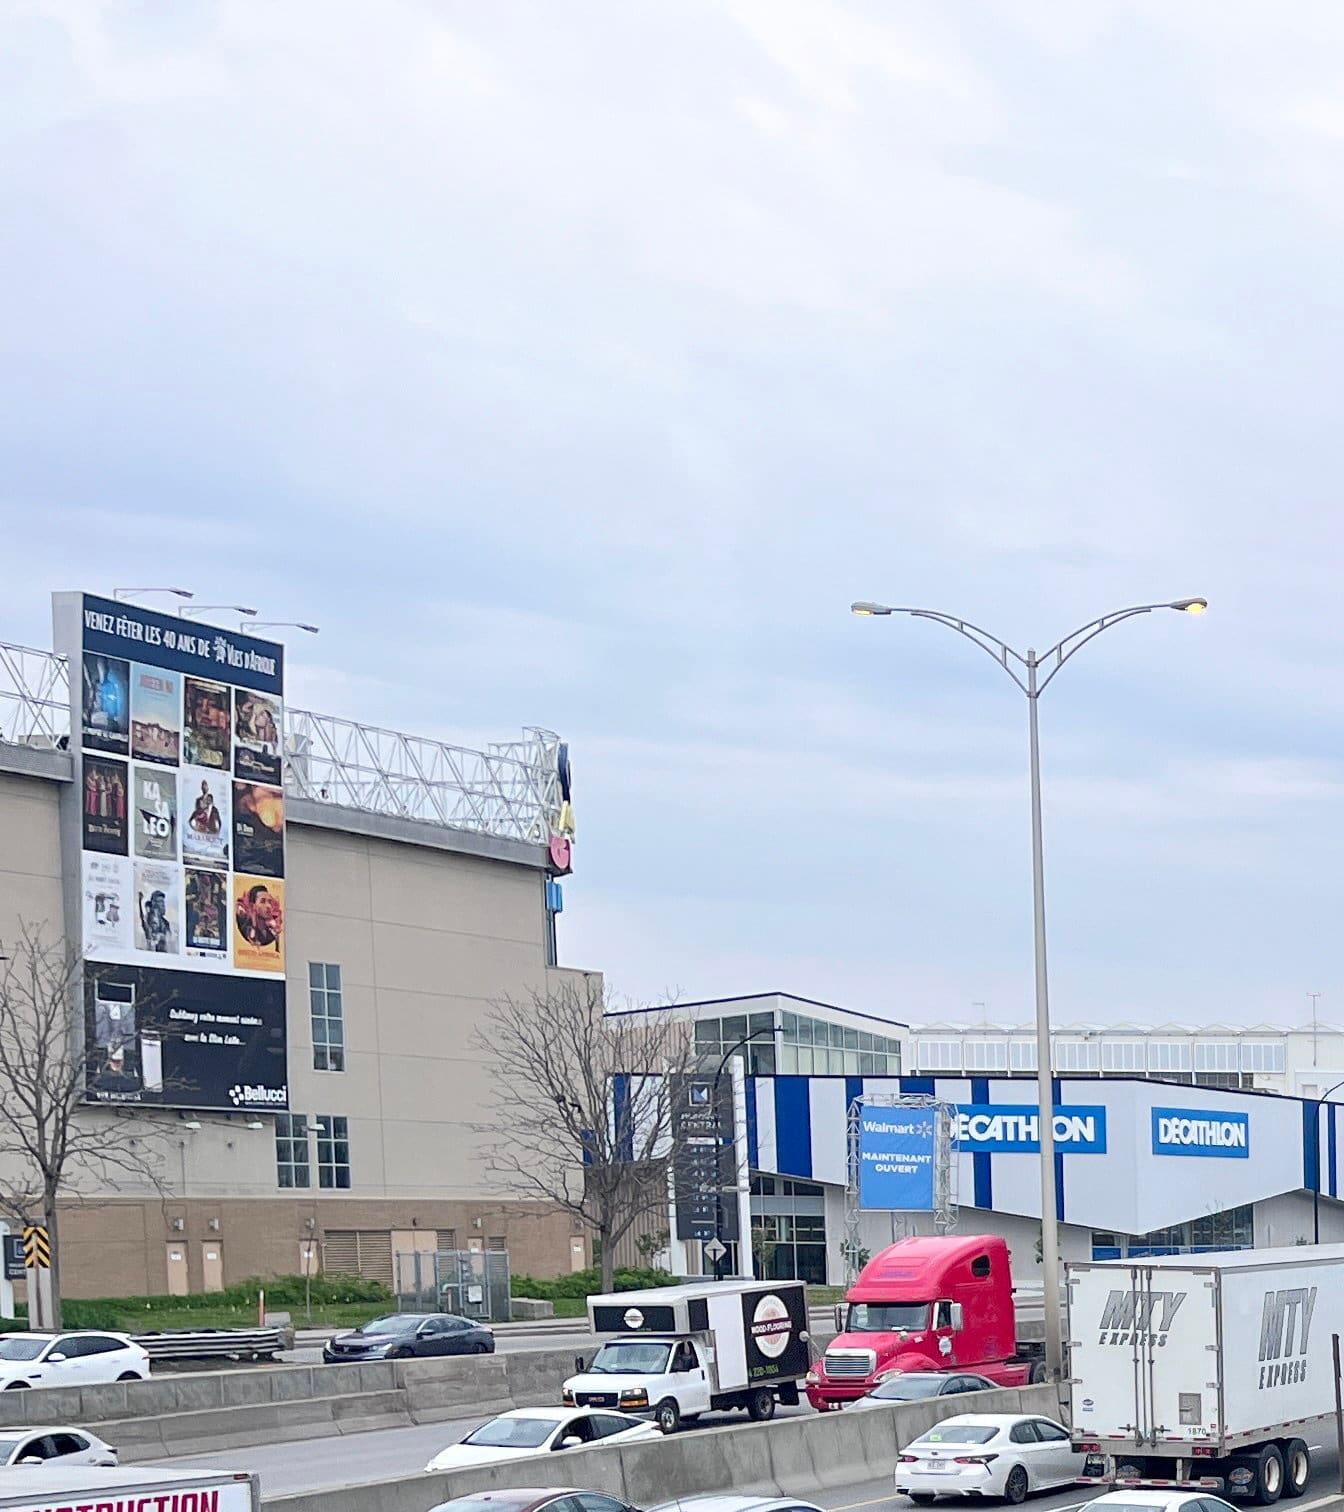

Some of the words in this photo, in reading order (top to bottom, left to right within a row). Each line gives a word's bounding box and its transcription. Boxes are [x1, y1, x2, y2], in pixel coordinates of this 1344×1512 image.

[84, 609, 115, 634] VENEZ
[116, 614, 144, 641] FÊTER
[145, 625, 162, 646] LES
[163, 630, 177, 649] 40
[177, 633, 196, 654] ANS
[197, 638, 210, 658] DE
[243, 1085, 287, 1102] Bellucci
[863, 1121, 914, 1134] Walmart
[862, 1152, 932, 1164] MAINTENANT
[875, 1164, 918, 1174] OUVERT
[1099, 1290, 1187, 1331] MTY
[1259, 1287, 1318, 1361] MTY
[1099, 1332, 1168, 1348] EXPRESS
[1259, 1359, 1307, 1389] EXPRESS
